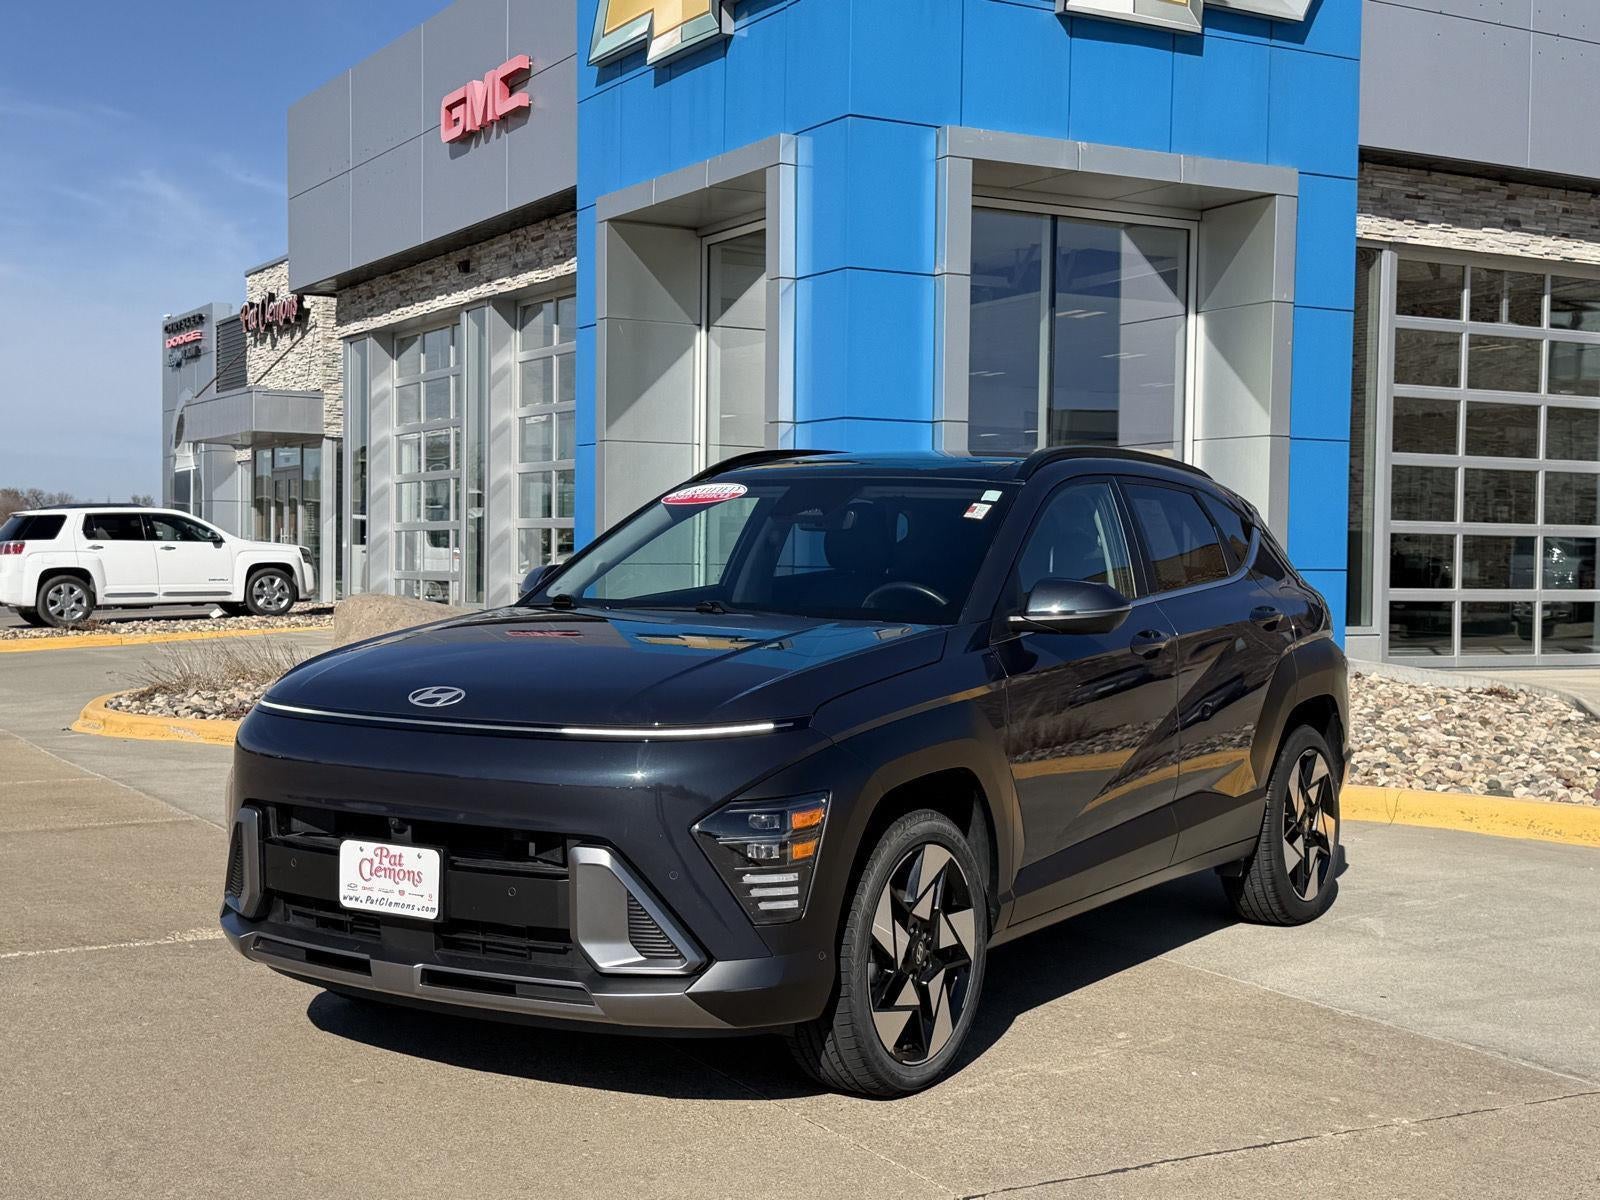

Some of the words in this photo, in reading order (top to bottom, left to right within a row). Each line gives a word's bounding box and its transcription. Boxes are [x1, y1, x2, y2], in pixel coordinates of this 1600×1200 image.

[440, 54, 530, 144] GMC
[240, 301, 258, 333] Pat
[258, 293, 299, 333] Clemons
[165, 330, 204, 349] DODGE
[373, 846, 404, 867] Pat
[358, 857, 424, 888] Clemons
